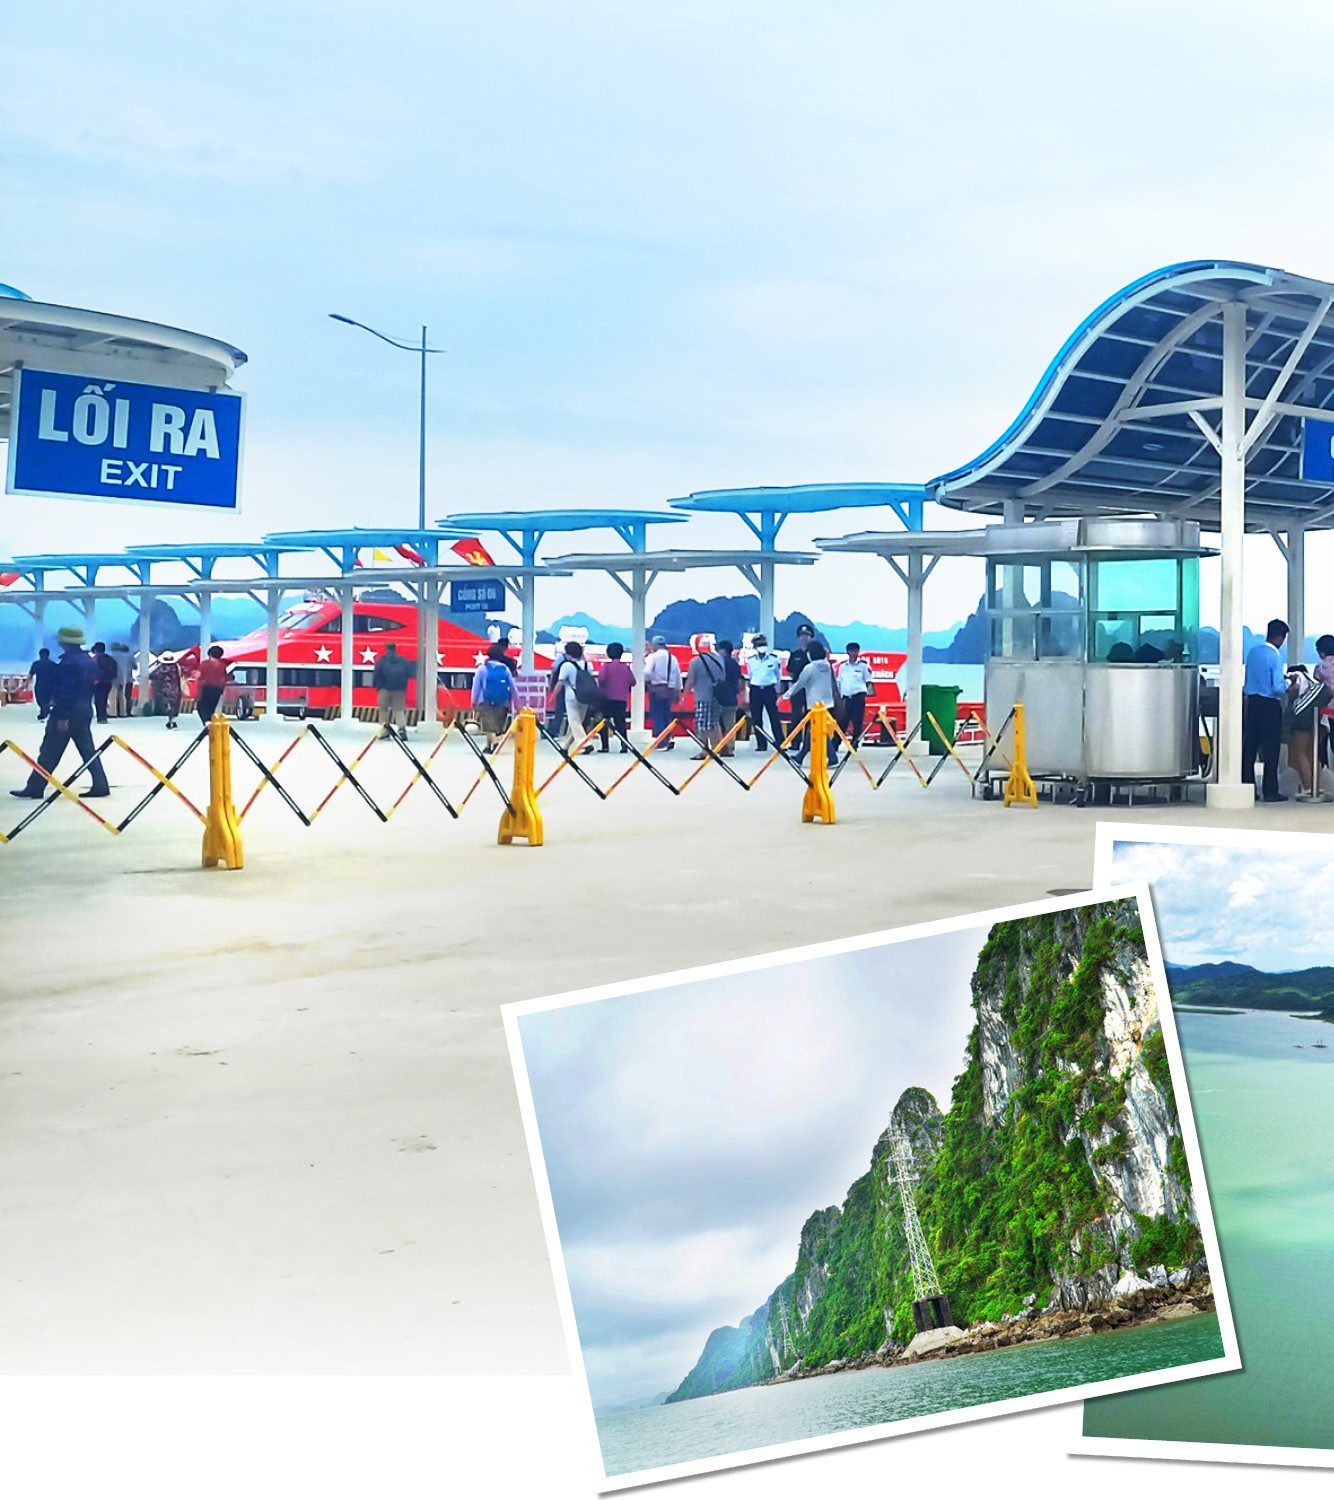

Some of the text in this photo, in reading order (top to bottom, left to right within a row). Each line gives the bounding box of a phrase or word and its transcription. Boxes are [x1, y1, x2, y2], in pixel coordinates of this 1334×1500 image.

[38, 383, 220, 460] LỐI RA
[100, 458, 183, 490] EXIT
